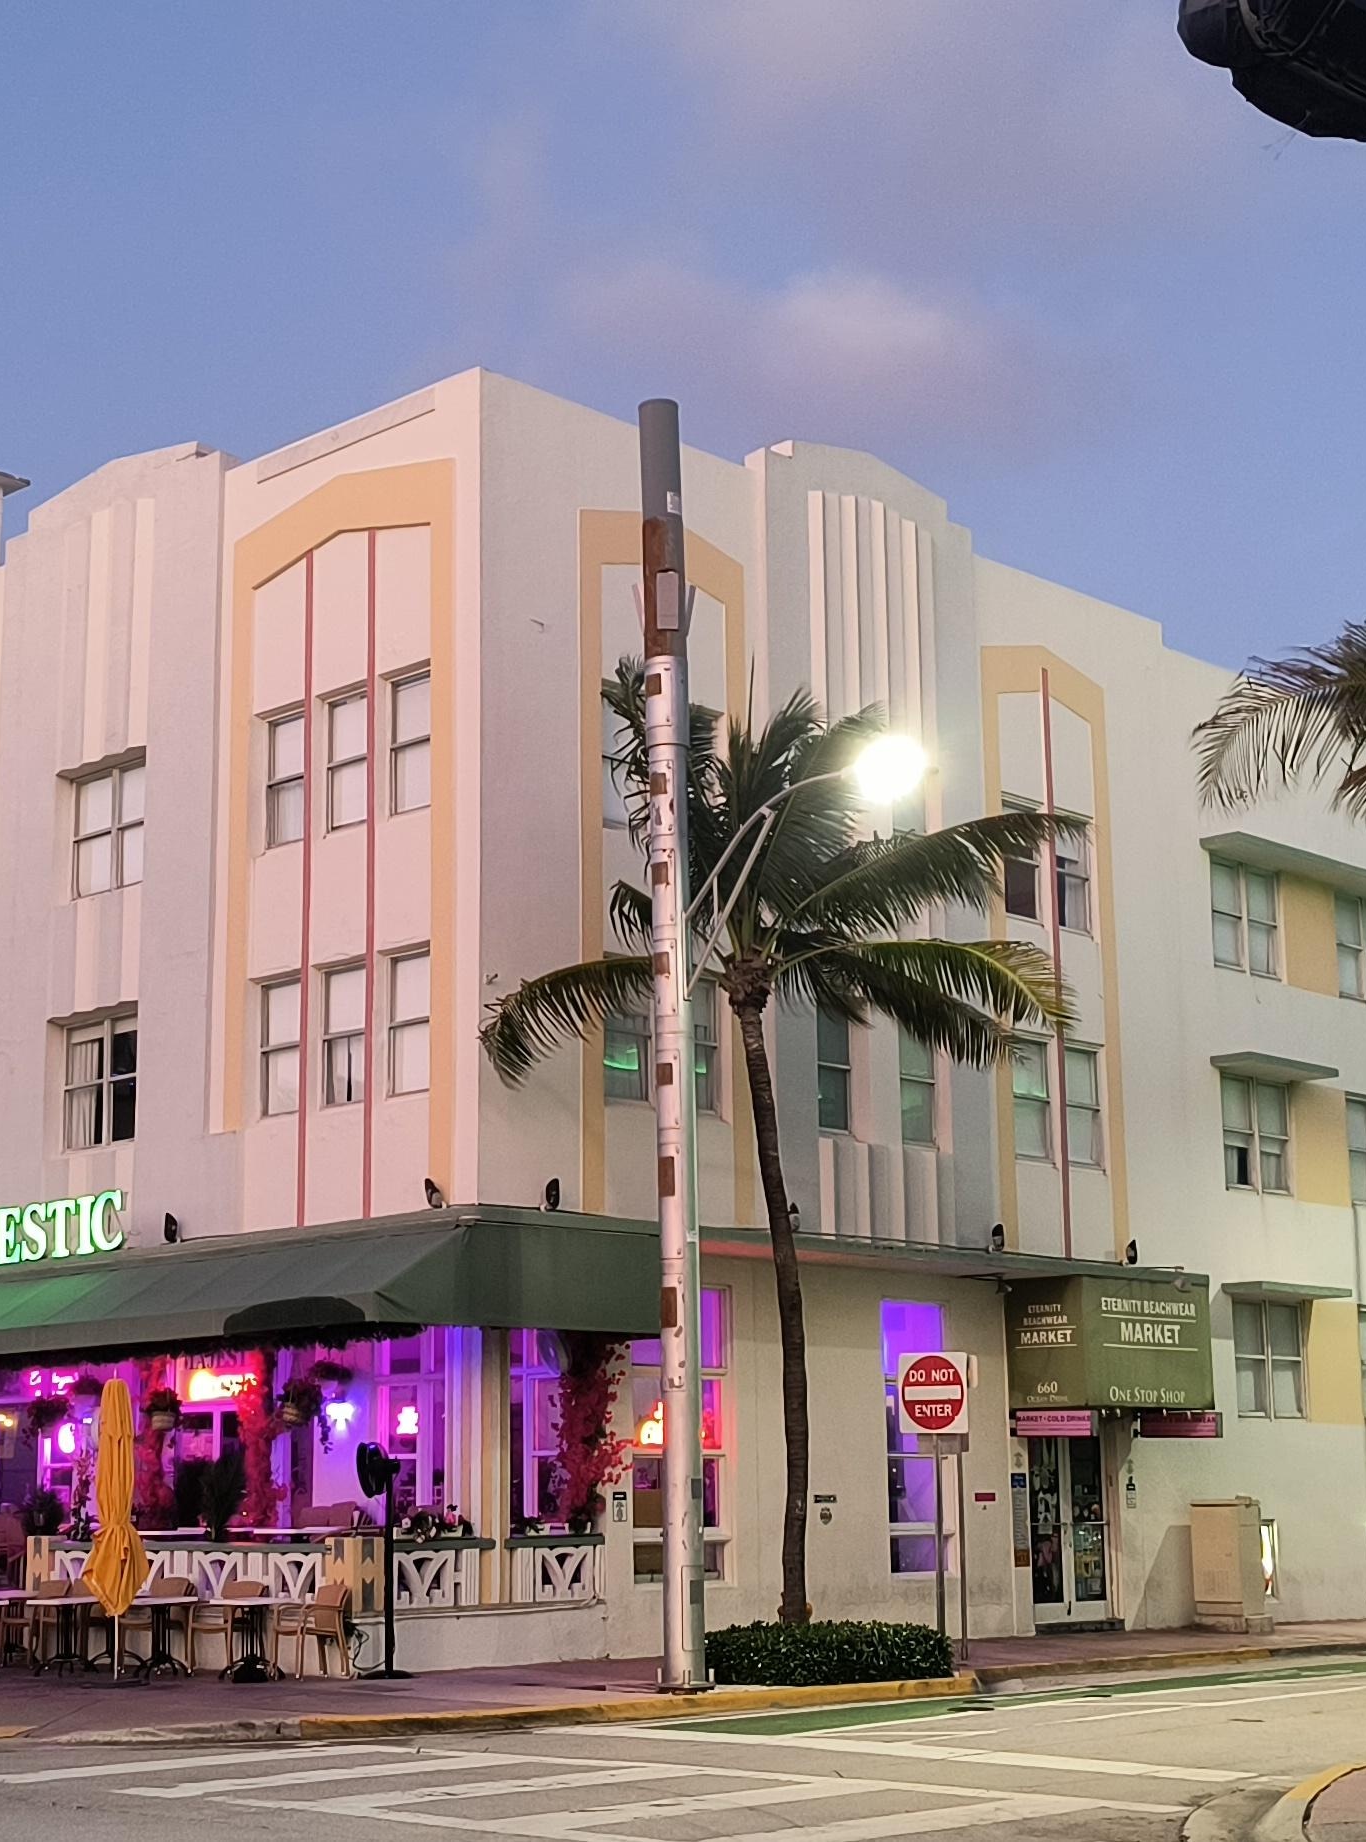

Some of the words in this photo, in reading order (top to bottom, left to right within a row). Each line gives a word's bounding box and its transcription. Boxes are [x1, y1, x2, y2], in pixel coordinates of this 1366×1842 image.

[1028, 1304, 1061, 1313] ETERNITY
[1101, 1297, 1142, 1314] ETERNITY
[1144, 1301, 1196, 1317] BEACHWEAR
[1023, 1315, 1068, 1326] BEACHWEAR
[1020, 1330, 1073, 1344] MARKET
[1120, 1321, 1181, 1345] MARKET
[909, 1369, 926, 1382] DO
[931, 1368, 956, 1382] NOT
[1037, 1381, 1058, 1394] 660
[1109, 1386, 1132, 1402] ONE
[1134, 1387, 1158, 1403] STOP
[1160, 1388, 1185, 1403] SHOP
[915, 1404, 952, 1416] ENTER
